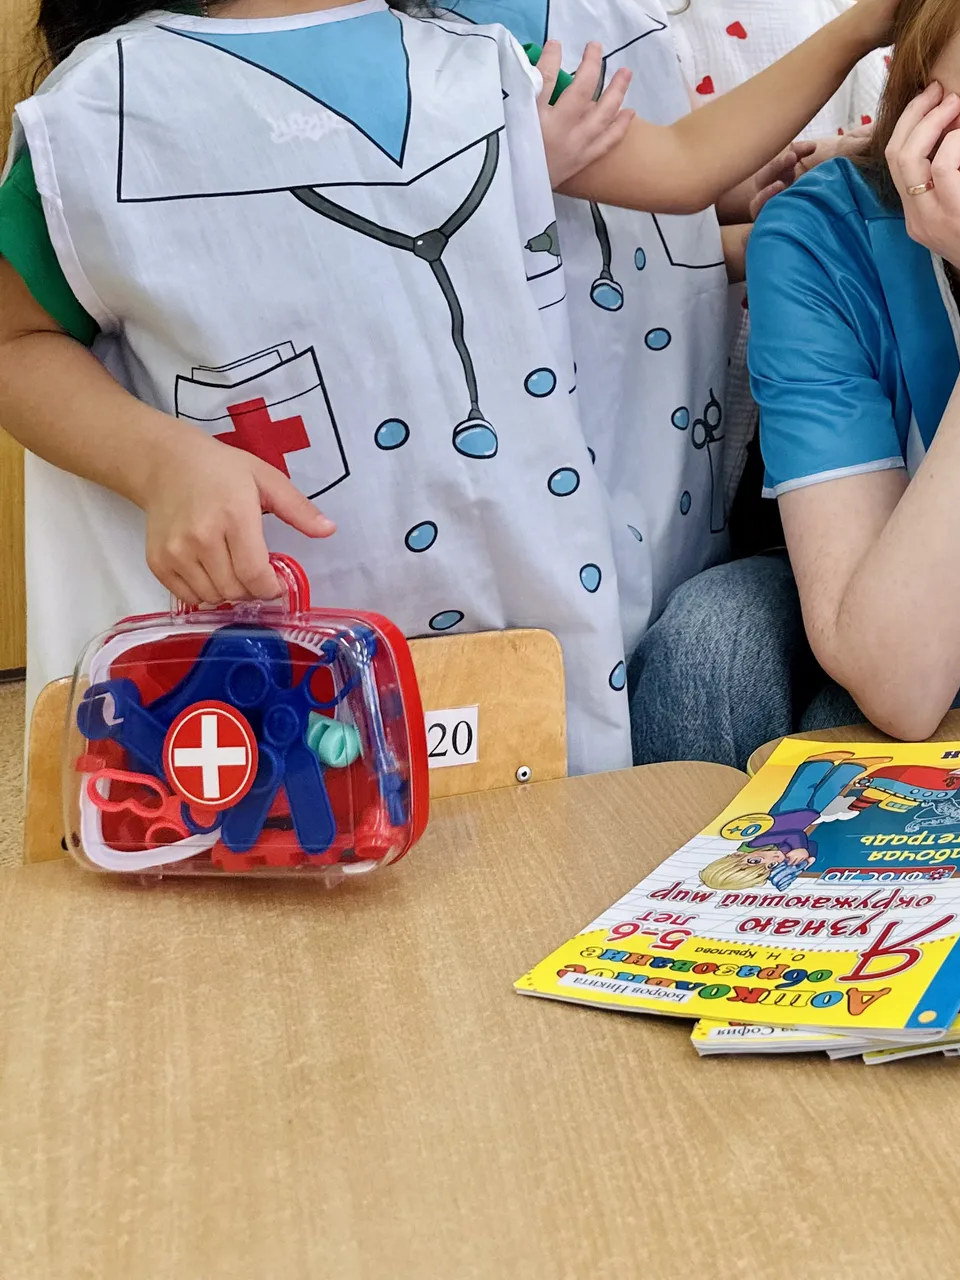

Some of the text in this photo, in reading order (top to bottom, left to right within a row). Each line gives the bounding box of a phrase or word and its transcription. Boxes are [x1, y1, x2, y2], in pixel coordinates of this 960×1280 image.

[427, 720, 473, 758] 20
[825, 869, 924, 883] ФГОС ДО
[650, 881, 935, 910] окружающий мир
[635, 910, 697, 926] лет
[604, 922, 694, 951] 5-6
[739, 910, 955, 982] Я узнаю
[695, 946, 757, 959] Крылова
[579, 946, 833, 989] образование
[572, 976, 688, 1003] Бобров Никита
[716, 1026, 775, 1036] София
